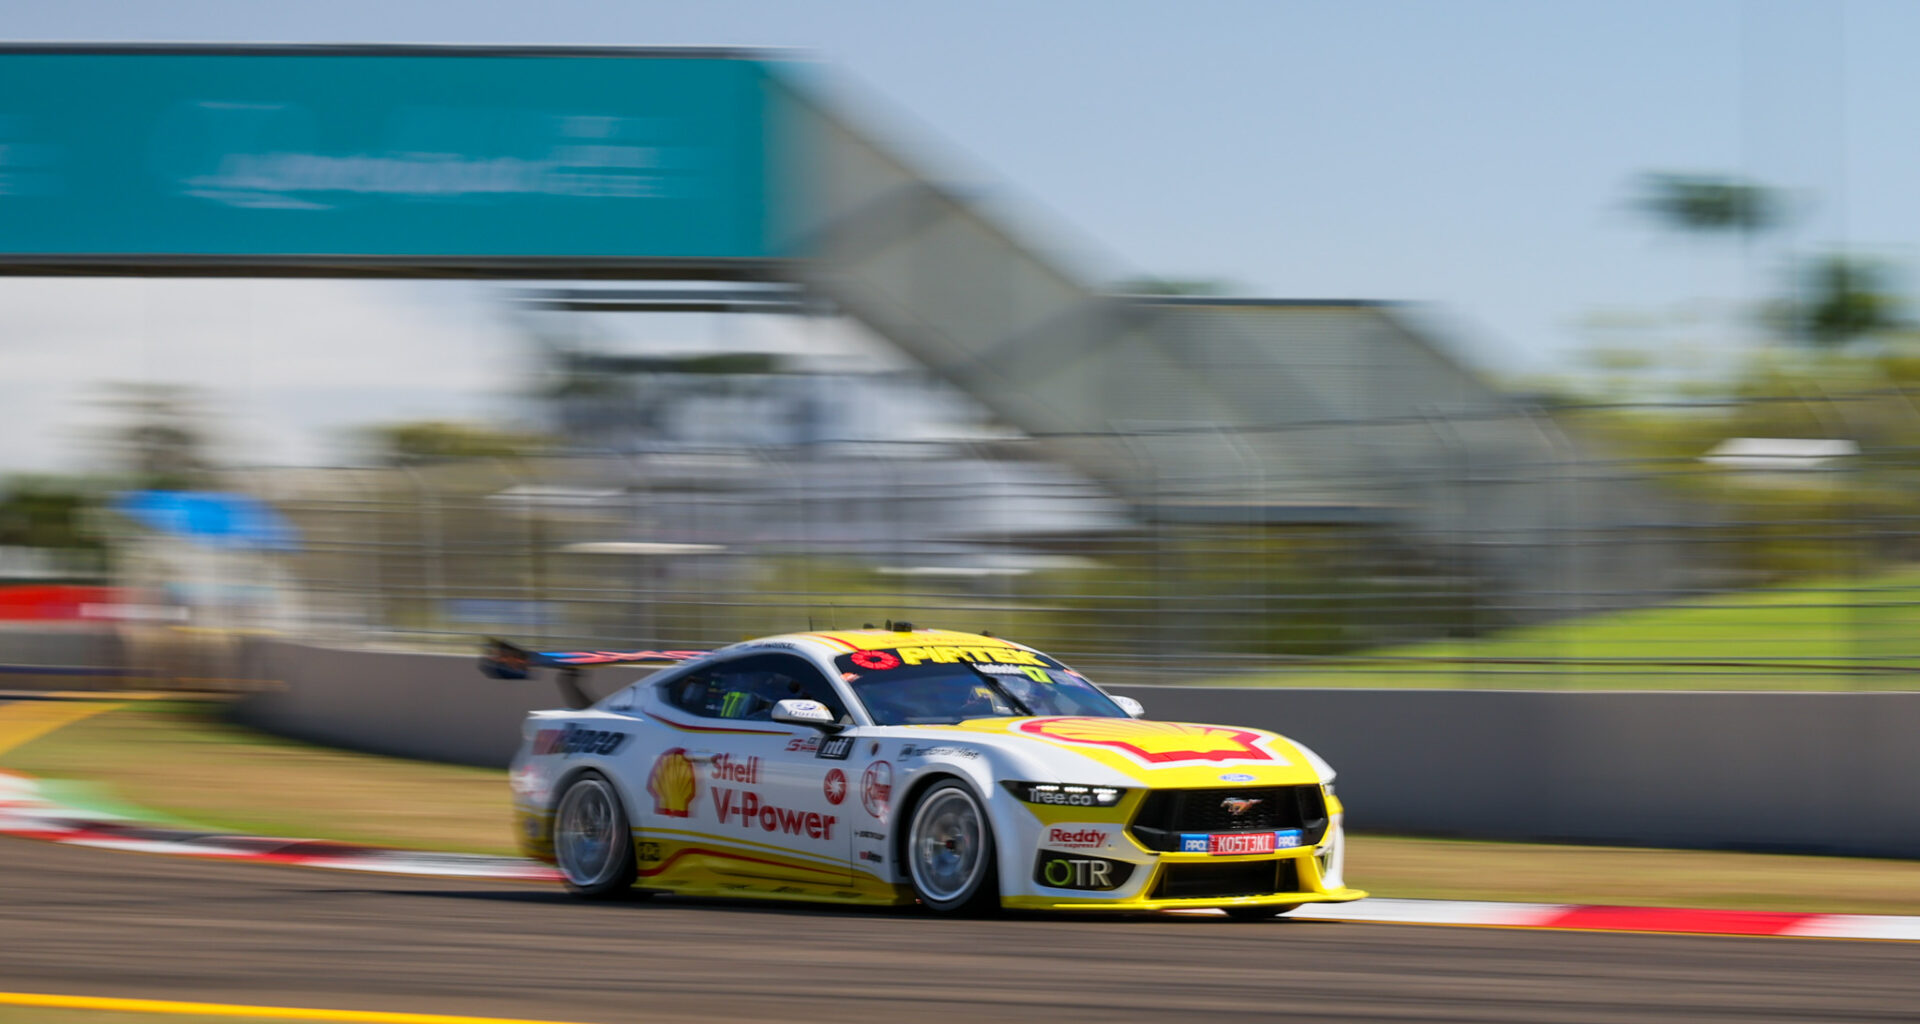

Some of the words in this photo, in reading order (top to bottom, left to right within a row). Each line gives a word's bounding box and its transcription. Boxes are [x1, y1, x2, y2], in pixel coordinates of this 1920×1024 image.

[896, 646, 1049, 667] PIRTEK
[1018, 665, 1054, 684] 17
[720, 691, 749, 718] 17
[711, 753, 762, 784] Shell
[1028, 788, 1092, 806] Tree.co
[711, 786, 838, 840] V-Power
[1049, 829, 1107, 848] Reddy
[1045, 859, 1113, 886] OTR
